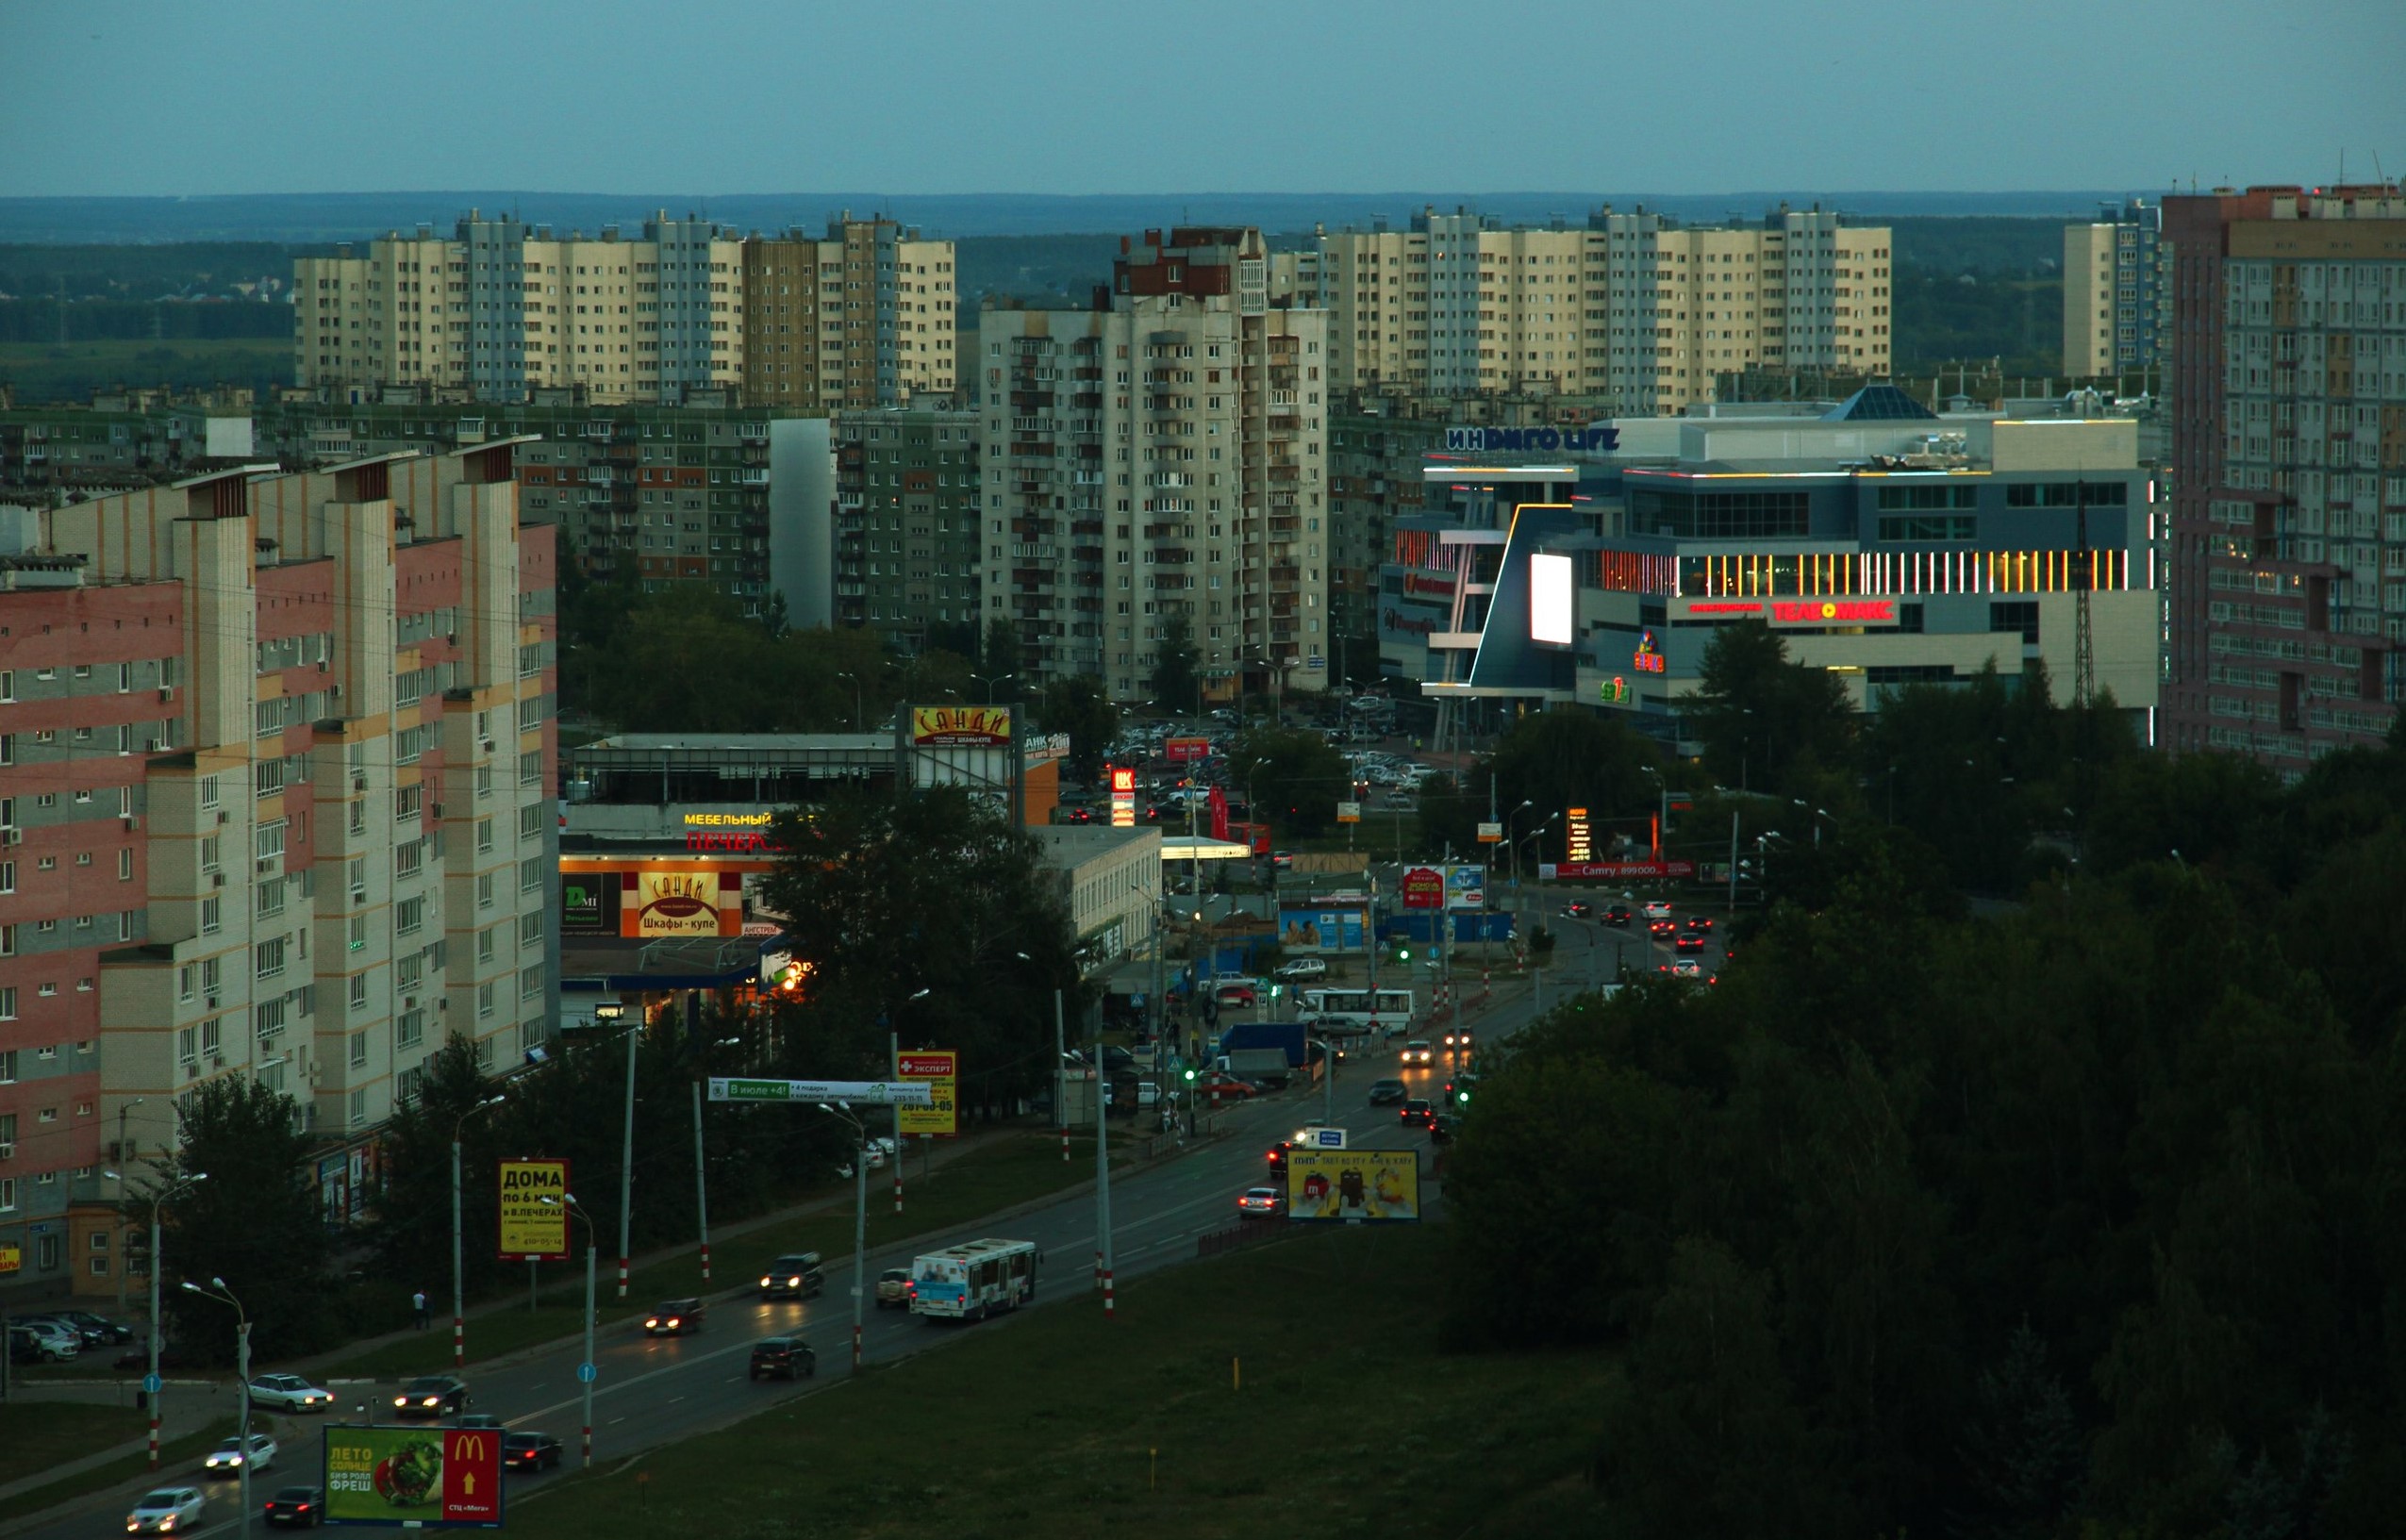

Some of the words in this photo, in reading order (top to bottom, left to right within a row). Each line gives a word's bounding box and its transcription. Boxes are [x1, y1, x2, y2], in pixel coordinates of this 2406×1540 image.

[684, 812, 772, 826] МЕБЕЛЬНЫЙ
[1582, 866, 1617, 878] Camry
[653, 876, 705, 899] САНДИ
[643, 918, 683, 932] Шкафы
[690, 919, 715, 931] купе
[731, 1085, 738, 1094] В
[740, 1086, 769, 1095] июле
[504, 1170, 563, 1189] ДОМА
[503, 1194, 520, 1202] по
[523, 1192, 531, 1202] 6
[511, 1208, 563, 1217] В.ПЕЧЕРАХ
[330, 1448, 373, 1461] ЛЕТО
[331, 1461, 372, 1472] СОЛНЦЕ
[330, 1481, 371, 1492] ФРЕШ
[448, 1504, 463, 1513] СТЦ
